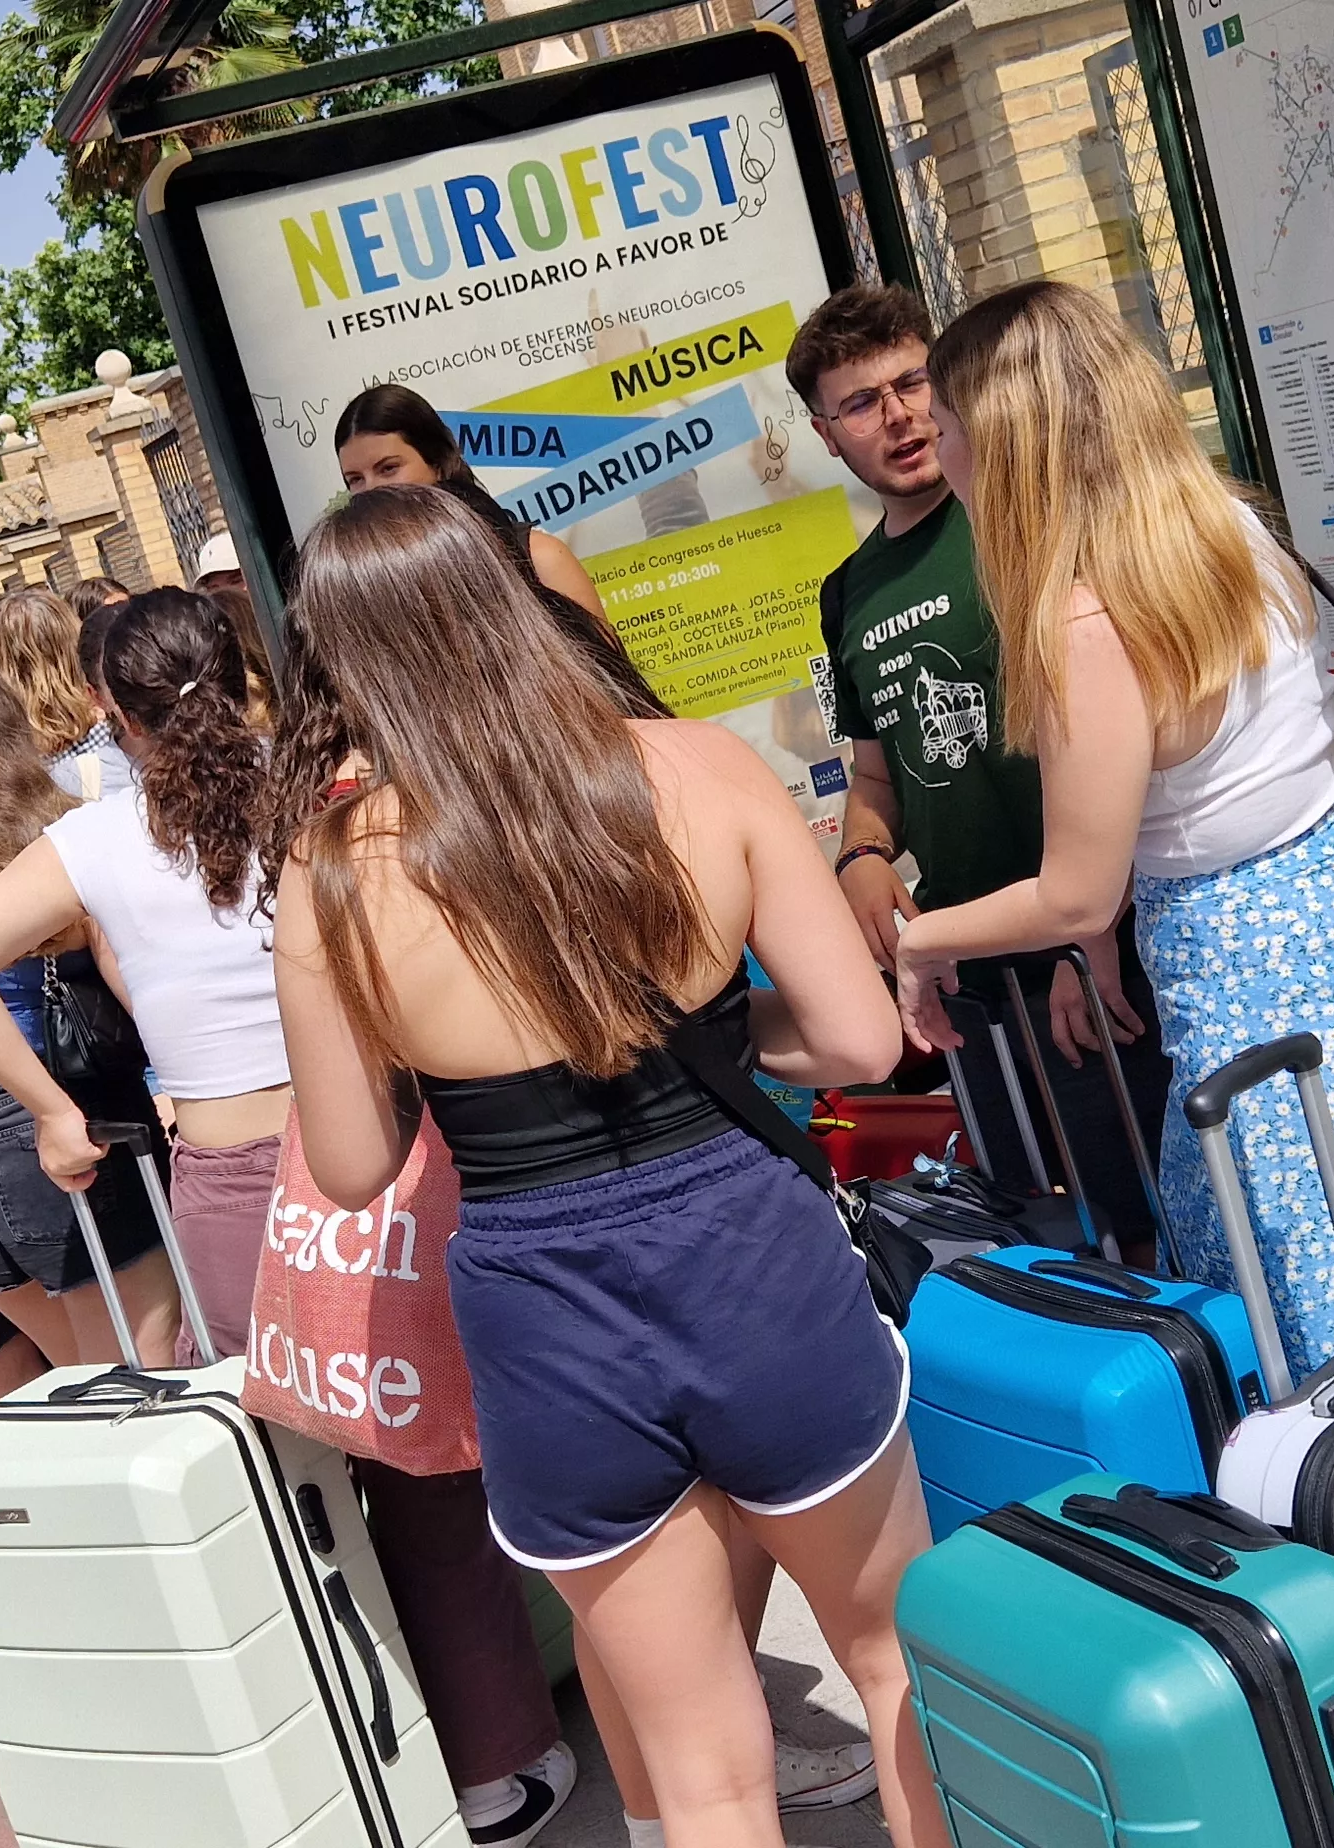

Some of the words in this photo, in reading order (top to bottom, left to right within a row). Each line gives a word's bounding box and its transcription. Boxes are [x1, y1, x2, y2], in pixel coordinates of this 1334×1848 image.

[1209, 31, 1218, 48] 1
[1229, 22, 1238, 39] 3
[279, 114, 738, 309] NEUROFEST
[327, 319, 337, 340] I
[342, 291, 454, 337] FESTIVAL
[457, 257, 588, 307] SOLIDARIO
[595, 252, 612, 273] A
[616, 230, 696, 268] FAVOR
[698, 222, 729, 247] DE
[361, 374, 382, 391] LA
[387, 343, 497, 385] ASOCIACIÓN
[501, 338, 523, 356] DE
[526, 313, 615, 348] ENFERMOS
[617, 280, 746, 327] NEUROLÓGICOS
[518, 335, 597, 368] OSCENSE
[610, 325, 765, 402] MÚSICA
[629, 559, 646, 575] de
[648, 541, 715, 568] Congresos
[717, 533, 735, 549] de
[735, 520, 784, 543] Huesca
[610, 580, 654, 605] 11:30
[656, 580, 667, 592] a
[668, 561, 721, 588] 20:30h
[610, 608, 665, 633] CIONES
[667, 602, 684, 617] DE
[668, 602, 739, 632] GARRAMPA
[748, 588, 785, 610] JOTAS
[682, 616, 744, 643] CÓCTELES
[754, 594, 820, 622] EMPODERA
[861, 594, 951, 651] QUINTOS
[662, 641, 714, 666] SANDRA
[716, 623, 765, 649] LANUZA
[765, 612, 806, 637] (Piano)
[655, 683, 677, 699] IFA
[686, 666, 738, 690] COMIDA
[739, 655, 770, 673] CON
[771, 642, 814, 664] PAELLA
[682, 684, 727, 709] apuntarse
[727, 665, 787, 698] previamente)
[878, 650, 913, 678] 2020
[871, 681, 904, 707] 2021
